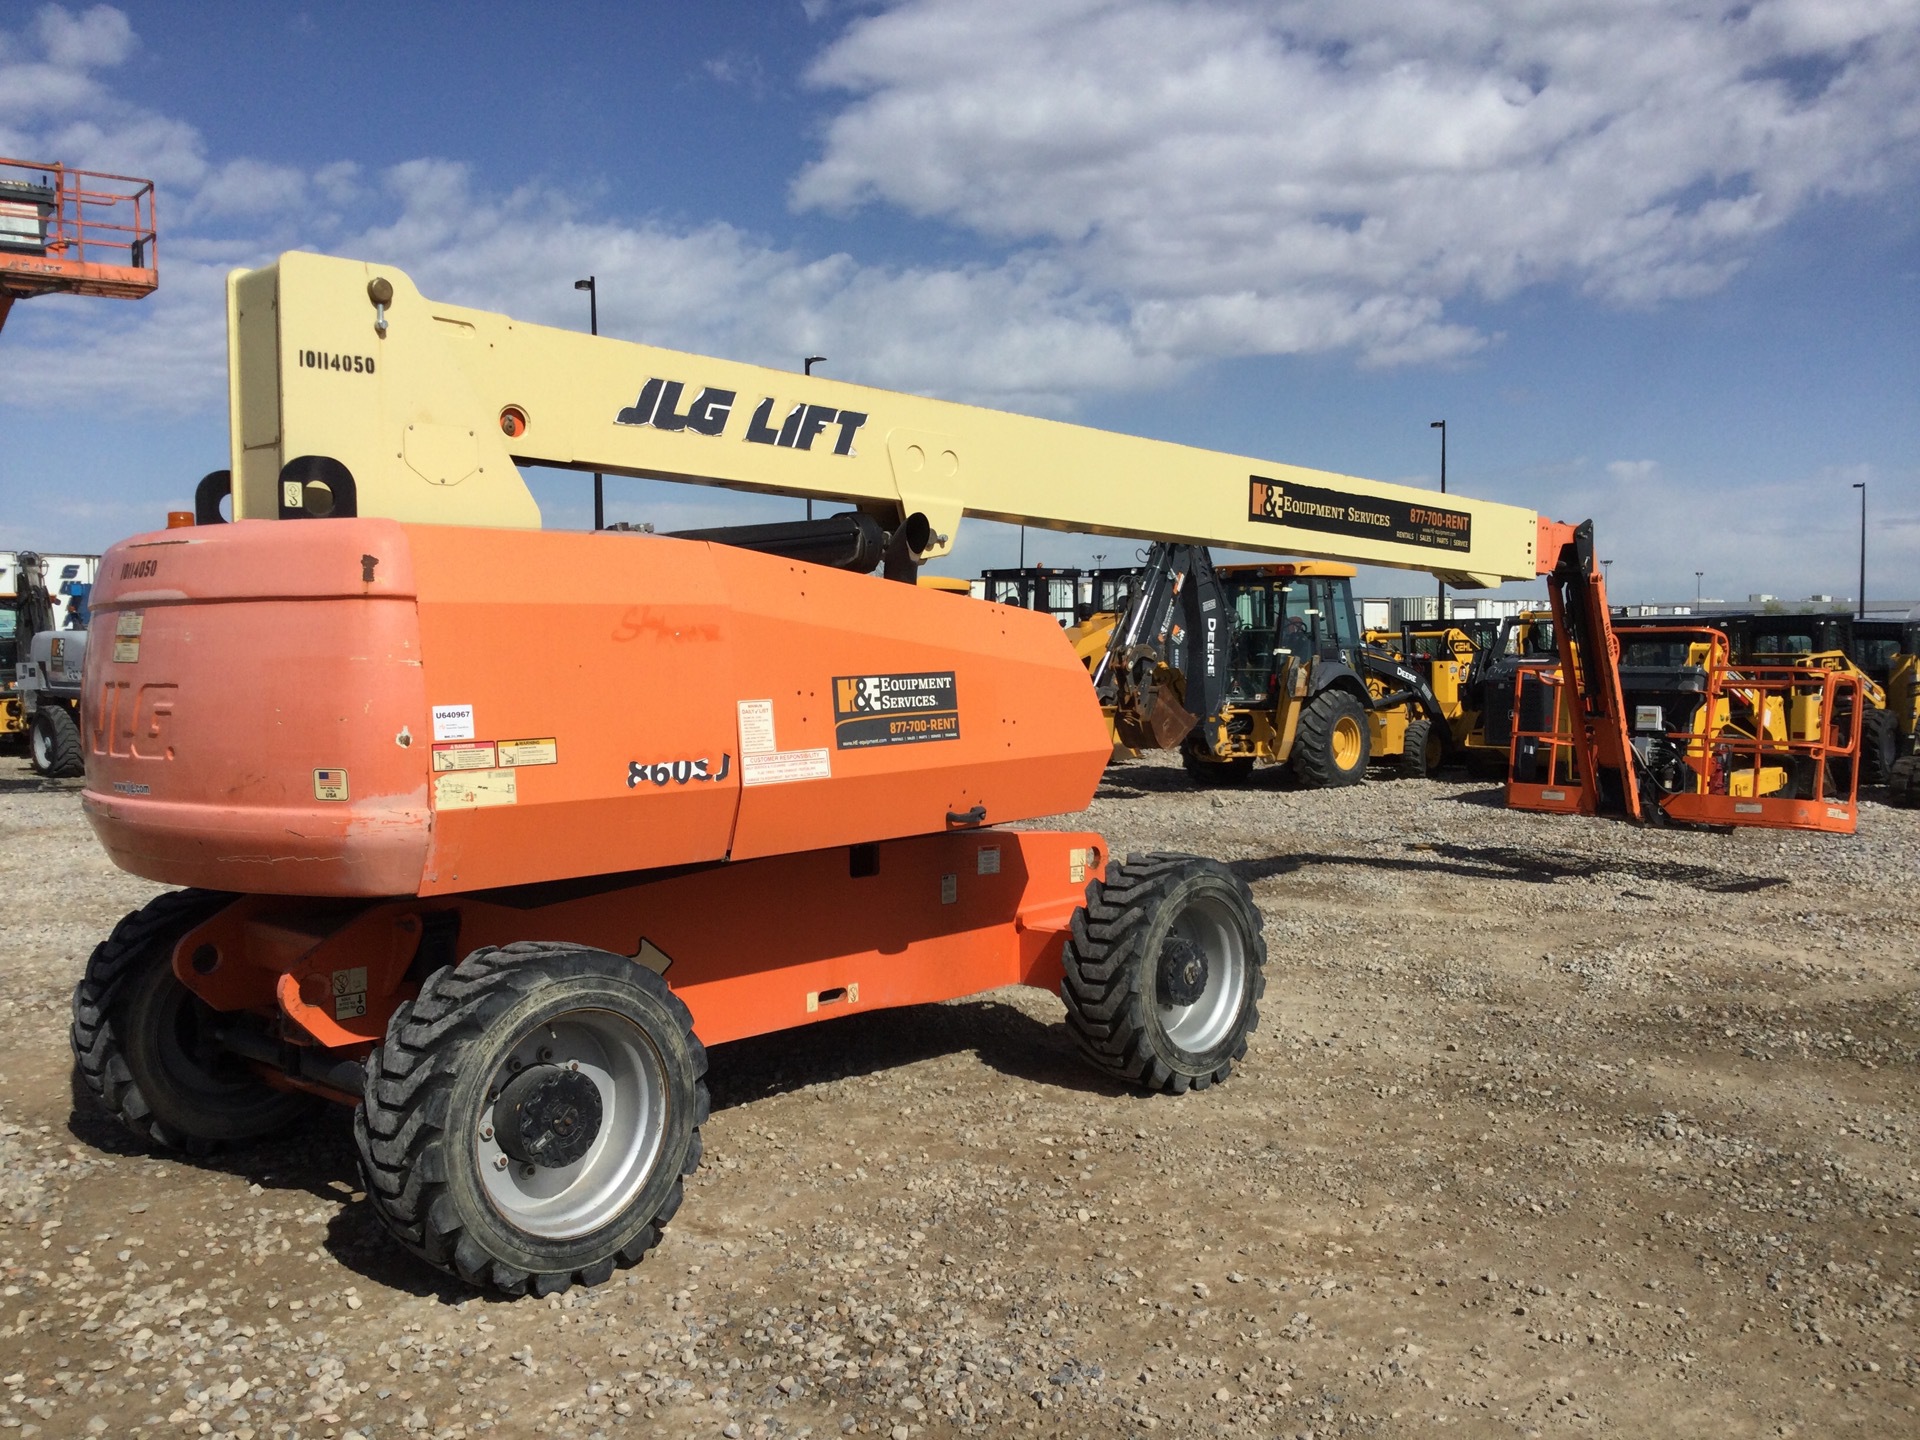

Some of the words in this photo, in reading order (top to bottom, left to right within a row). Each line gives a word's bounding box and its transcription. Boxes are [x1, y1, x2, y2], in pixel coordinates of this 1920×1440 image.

[299, 349, 375, 374] 10114050
[613, 377, 737, 437] JLG
[742, 396, 869, 457] LIFT
[1410, 508, 1469, 531] 877-700-RENT
[1207, 618, 1217, 677] DEERE
[1454, 642, 1473, 652] GEHL
[1396, 666, 1417, 683] DEERE
[435, 711, 470, 719] U640967
[889, 717, 957, 734] 877-700-RENT
[749, 755, 779, 763] CUSTOMER
[779, 752, 820, 761] RESPONSIBILITY
